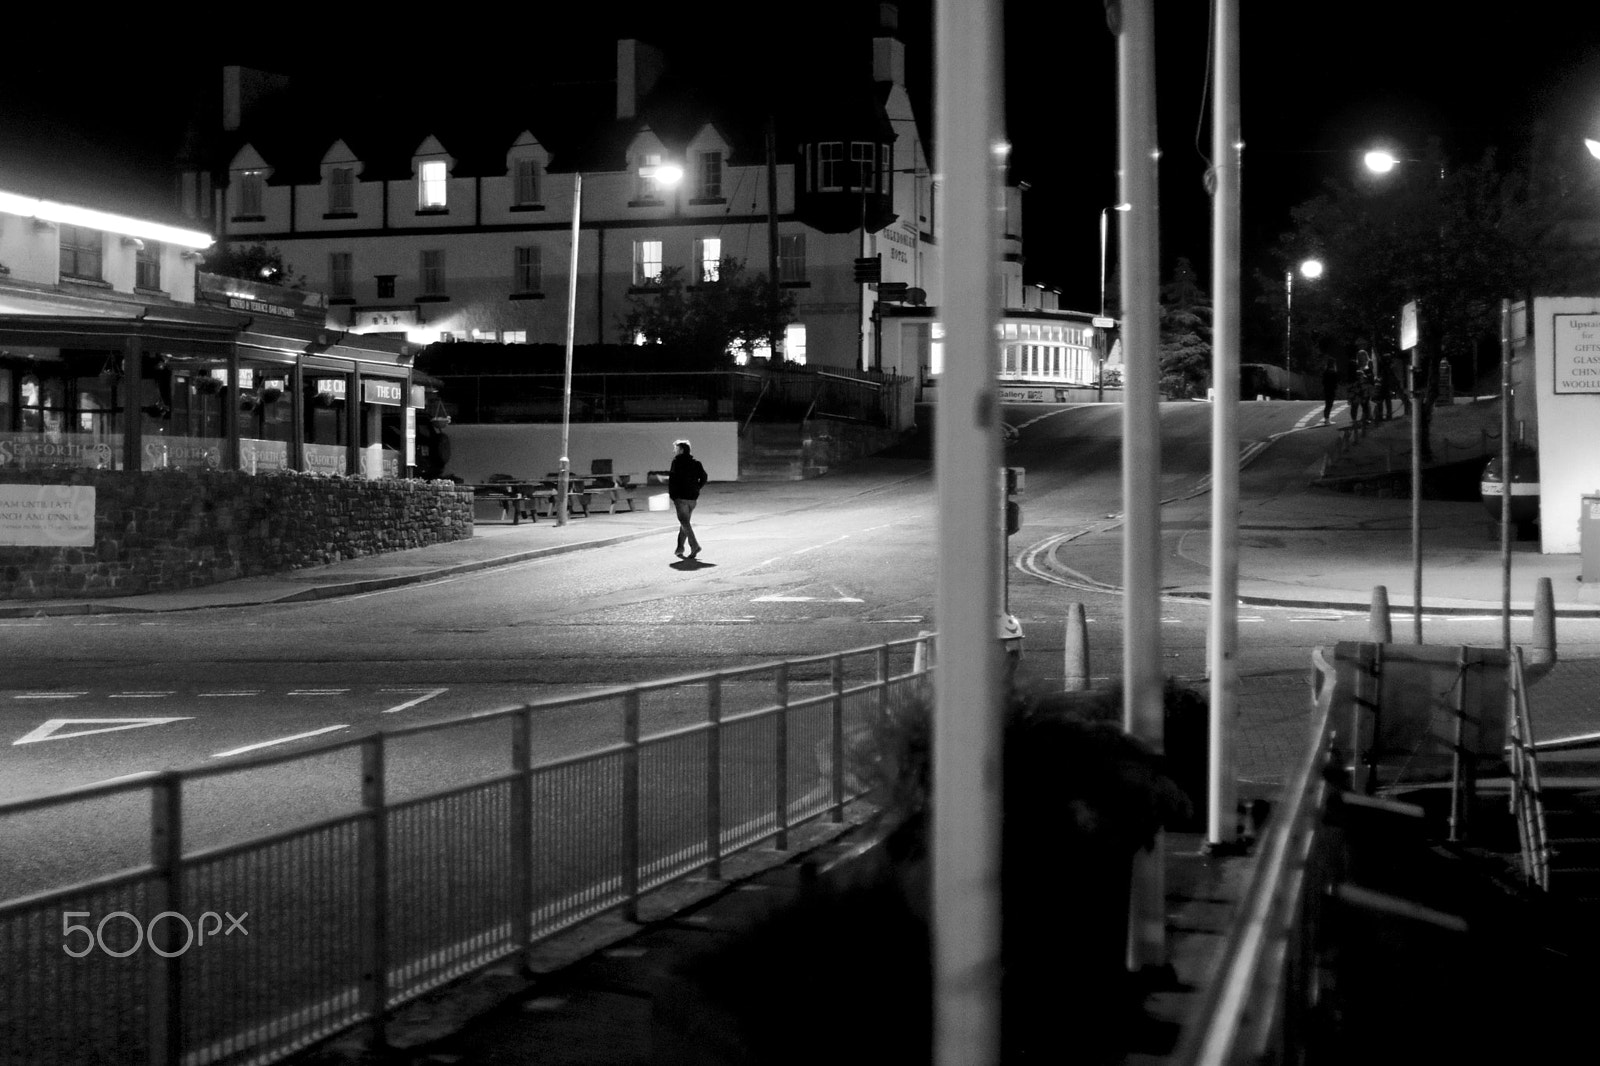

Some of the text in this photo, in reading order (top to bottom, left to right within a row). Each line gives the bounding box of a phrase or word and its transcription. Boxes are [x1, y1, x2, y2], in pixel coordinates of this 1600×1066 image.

[1571, 368, 1600, 376] CHIN
[376, 385, 390, 398] THE
[999, 390, 1025, 399] Gallery
[26, 512, 45, 520] AND
